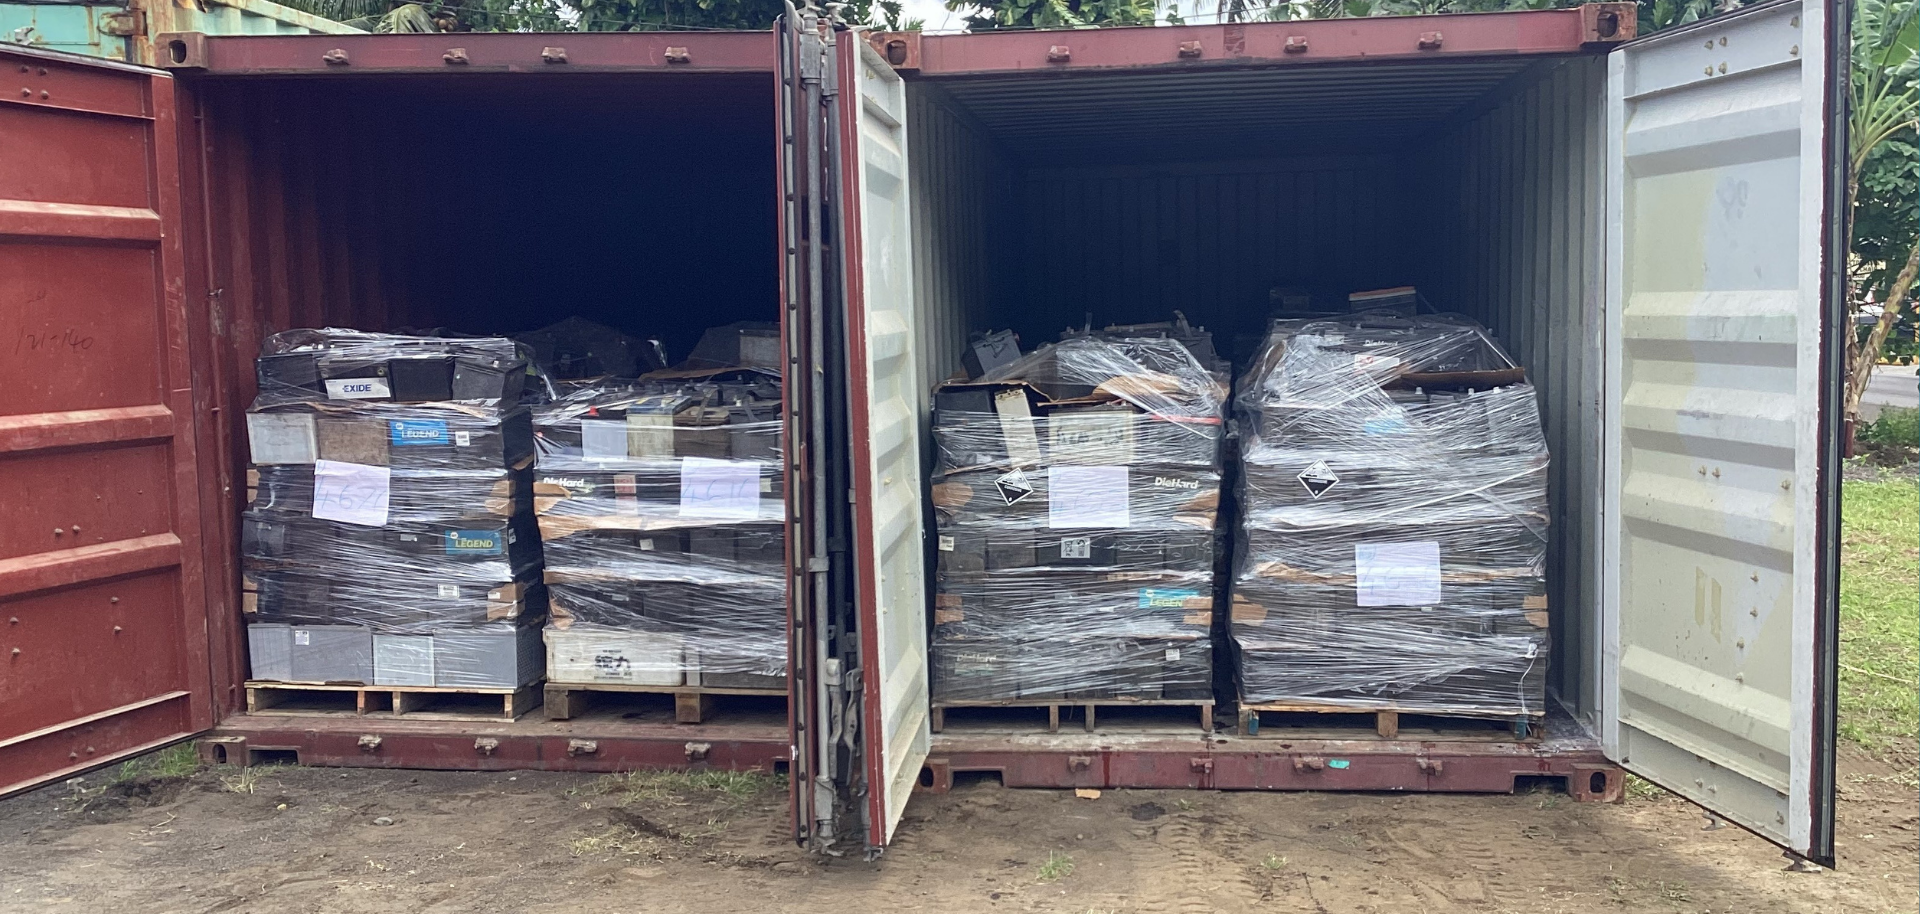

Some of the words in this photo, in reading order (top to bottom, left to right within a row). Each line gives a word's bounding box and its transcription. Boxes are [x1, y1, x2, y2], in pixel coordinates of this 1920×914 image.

[15, 325, 94, 354] 121-140
[342, 384, 372, 393] EXIDE
[1154, 476, 1199, 489] DieHard
[455, 539, 494, 549] LEGEND
